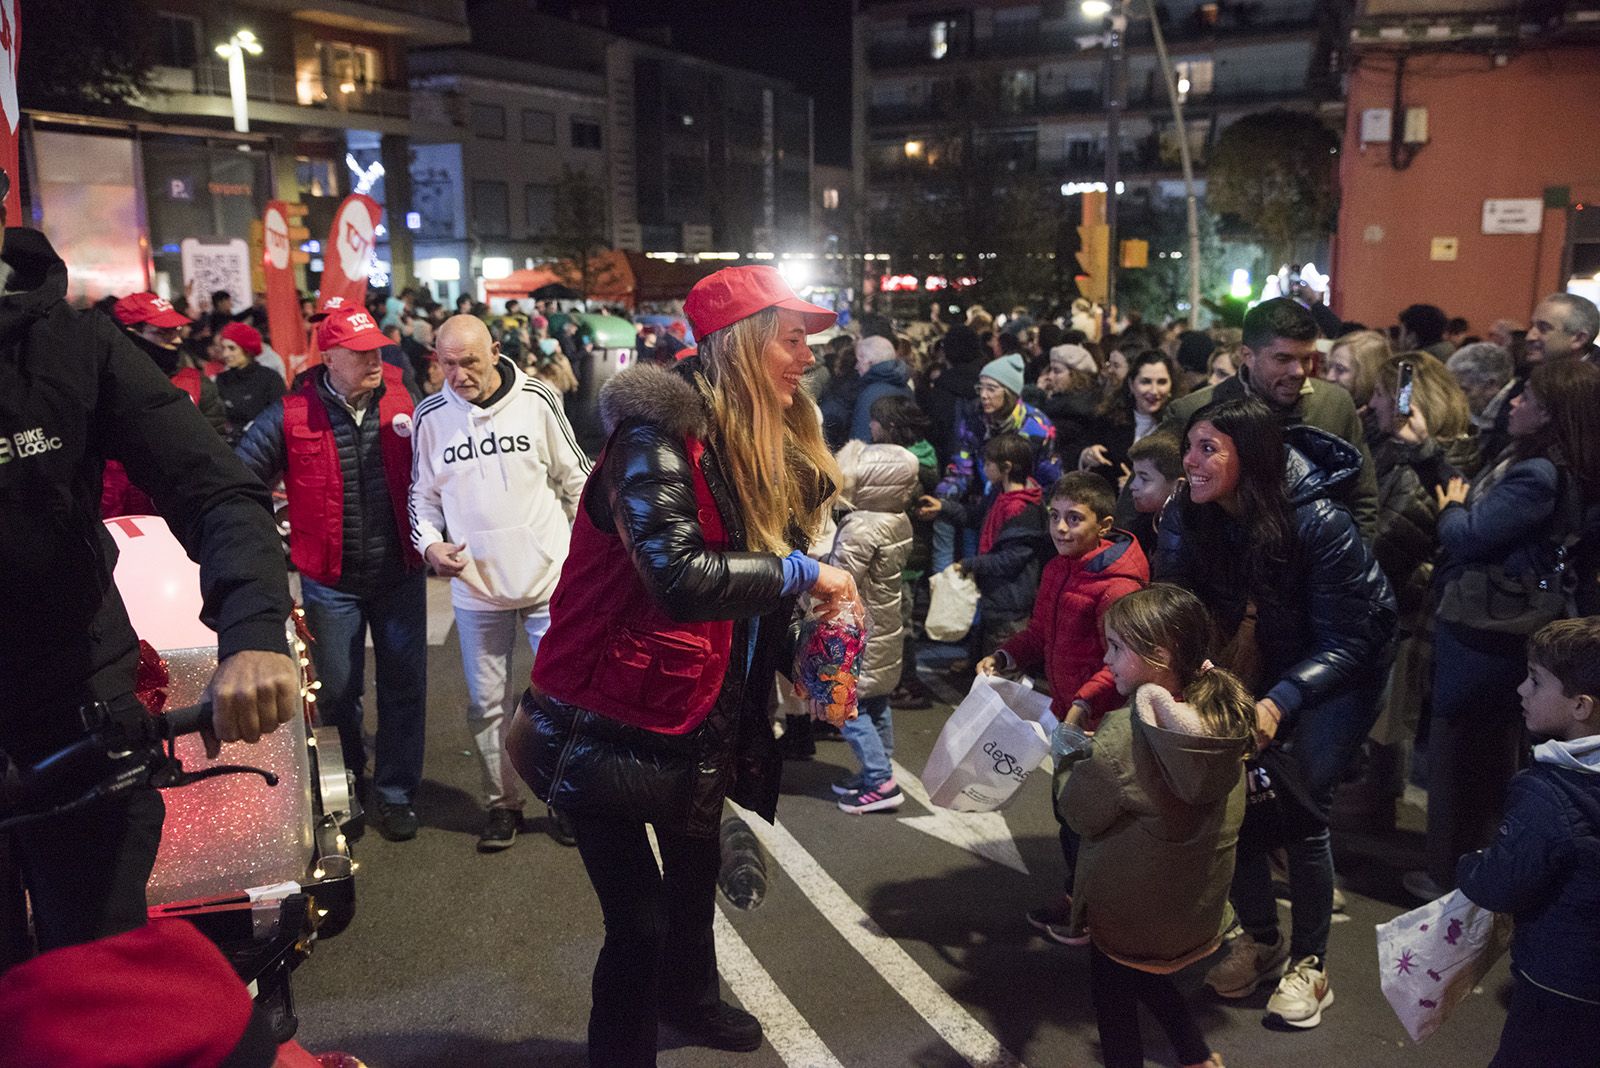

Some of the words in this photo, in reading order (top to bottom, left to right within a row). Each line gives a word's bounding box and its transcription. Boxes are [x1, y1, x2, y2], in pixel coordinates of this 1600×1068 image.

[13, 428, 46, 446] BIKE
[17, 437, 63, 458] LOGIC
[443, 431, 531, 464] adidas
